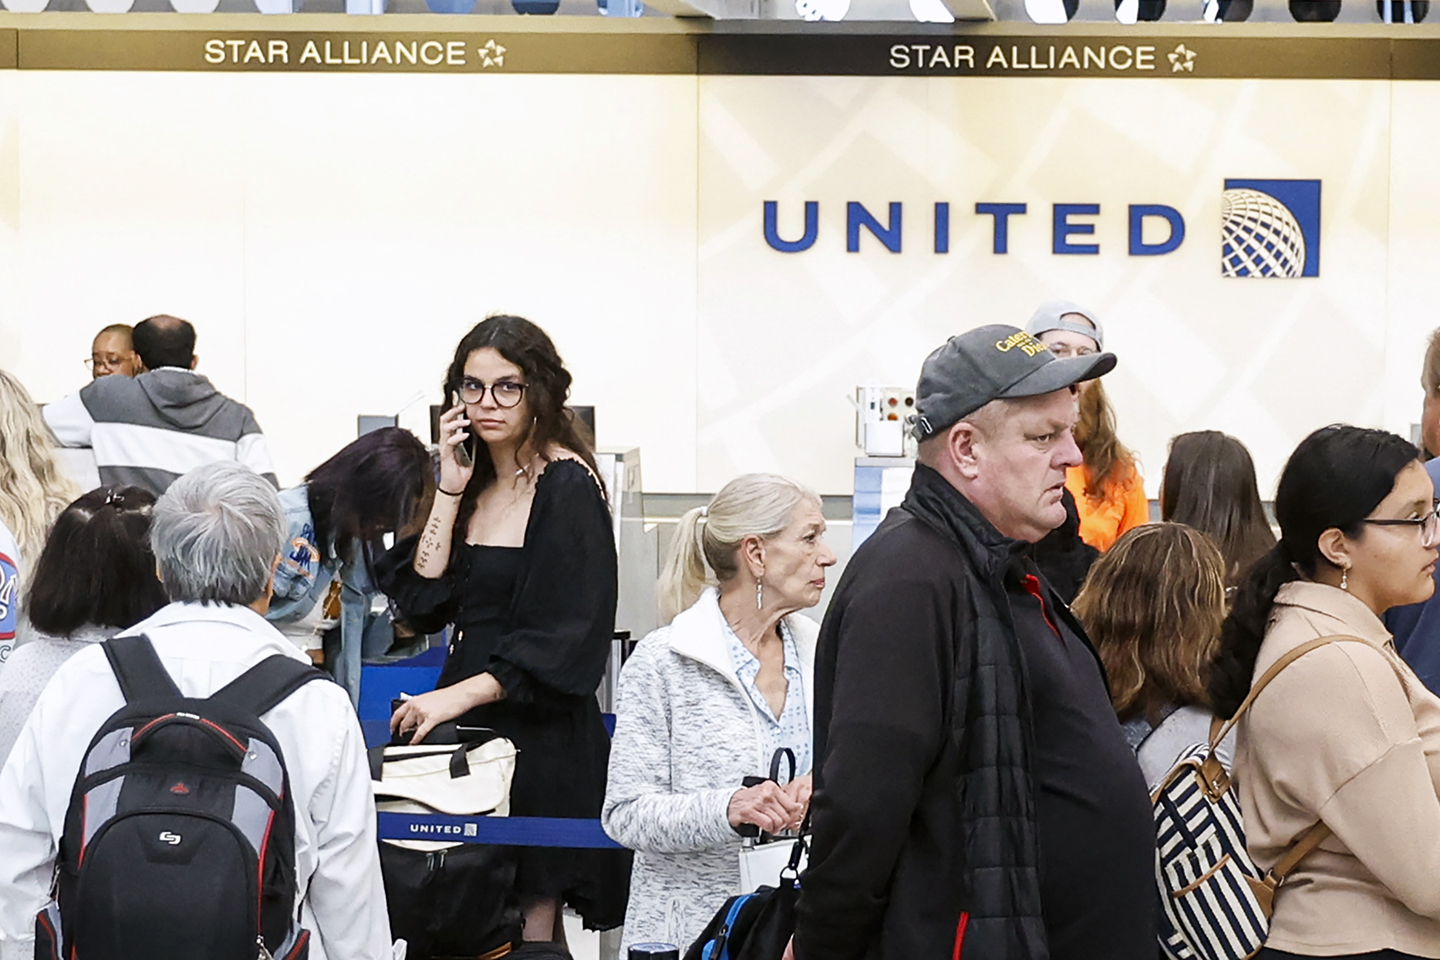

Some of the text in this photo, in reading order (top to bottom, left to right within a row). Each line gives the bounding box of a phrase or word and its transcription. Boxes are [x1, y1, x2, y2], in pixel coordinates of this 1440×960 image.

[204, 39, 466, 65] STAR ALLIANCE
[889, 44, 1156, 70] STAR ALLIANCE
[763, 200, 1187, 256] UNITED
[410, 824, 462, 834] UNITED
